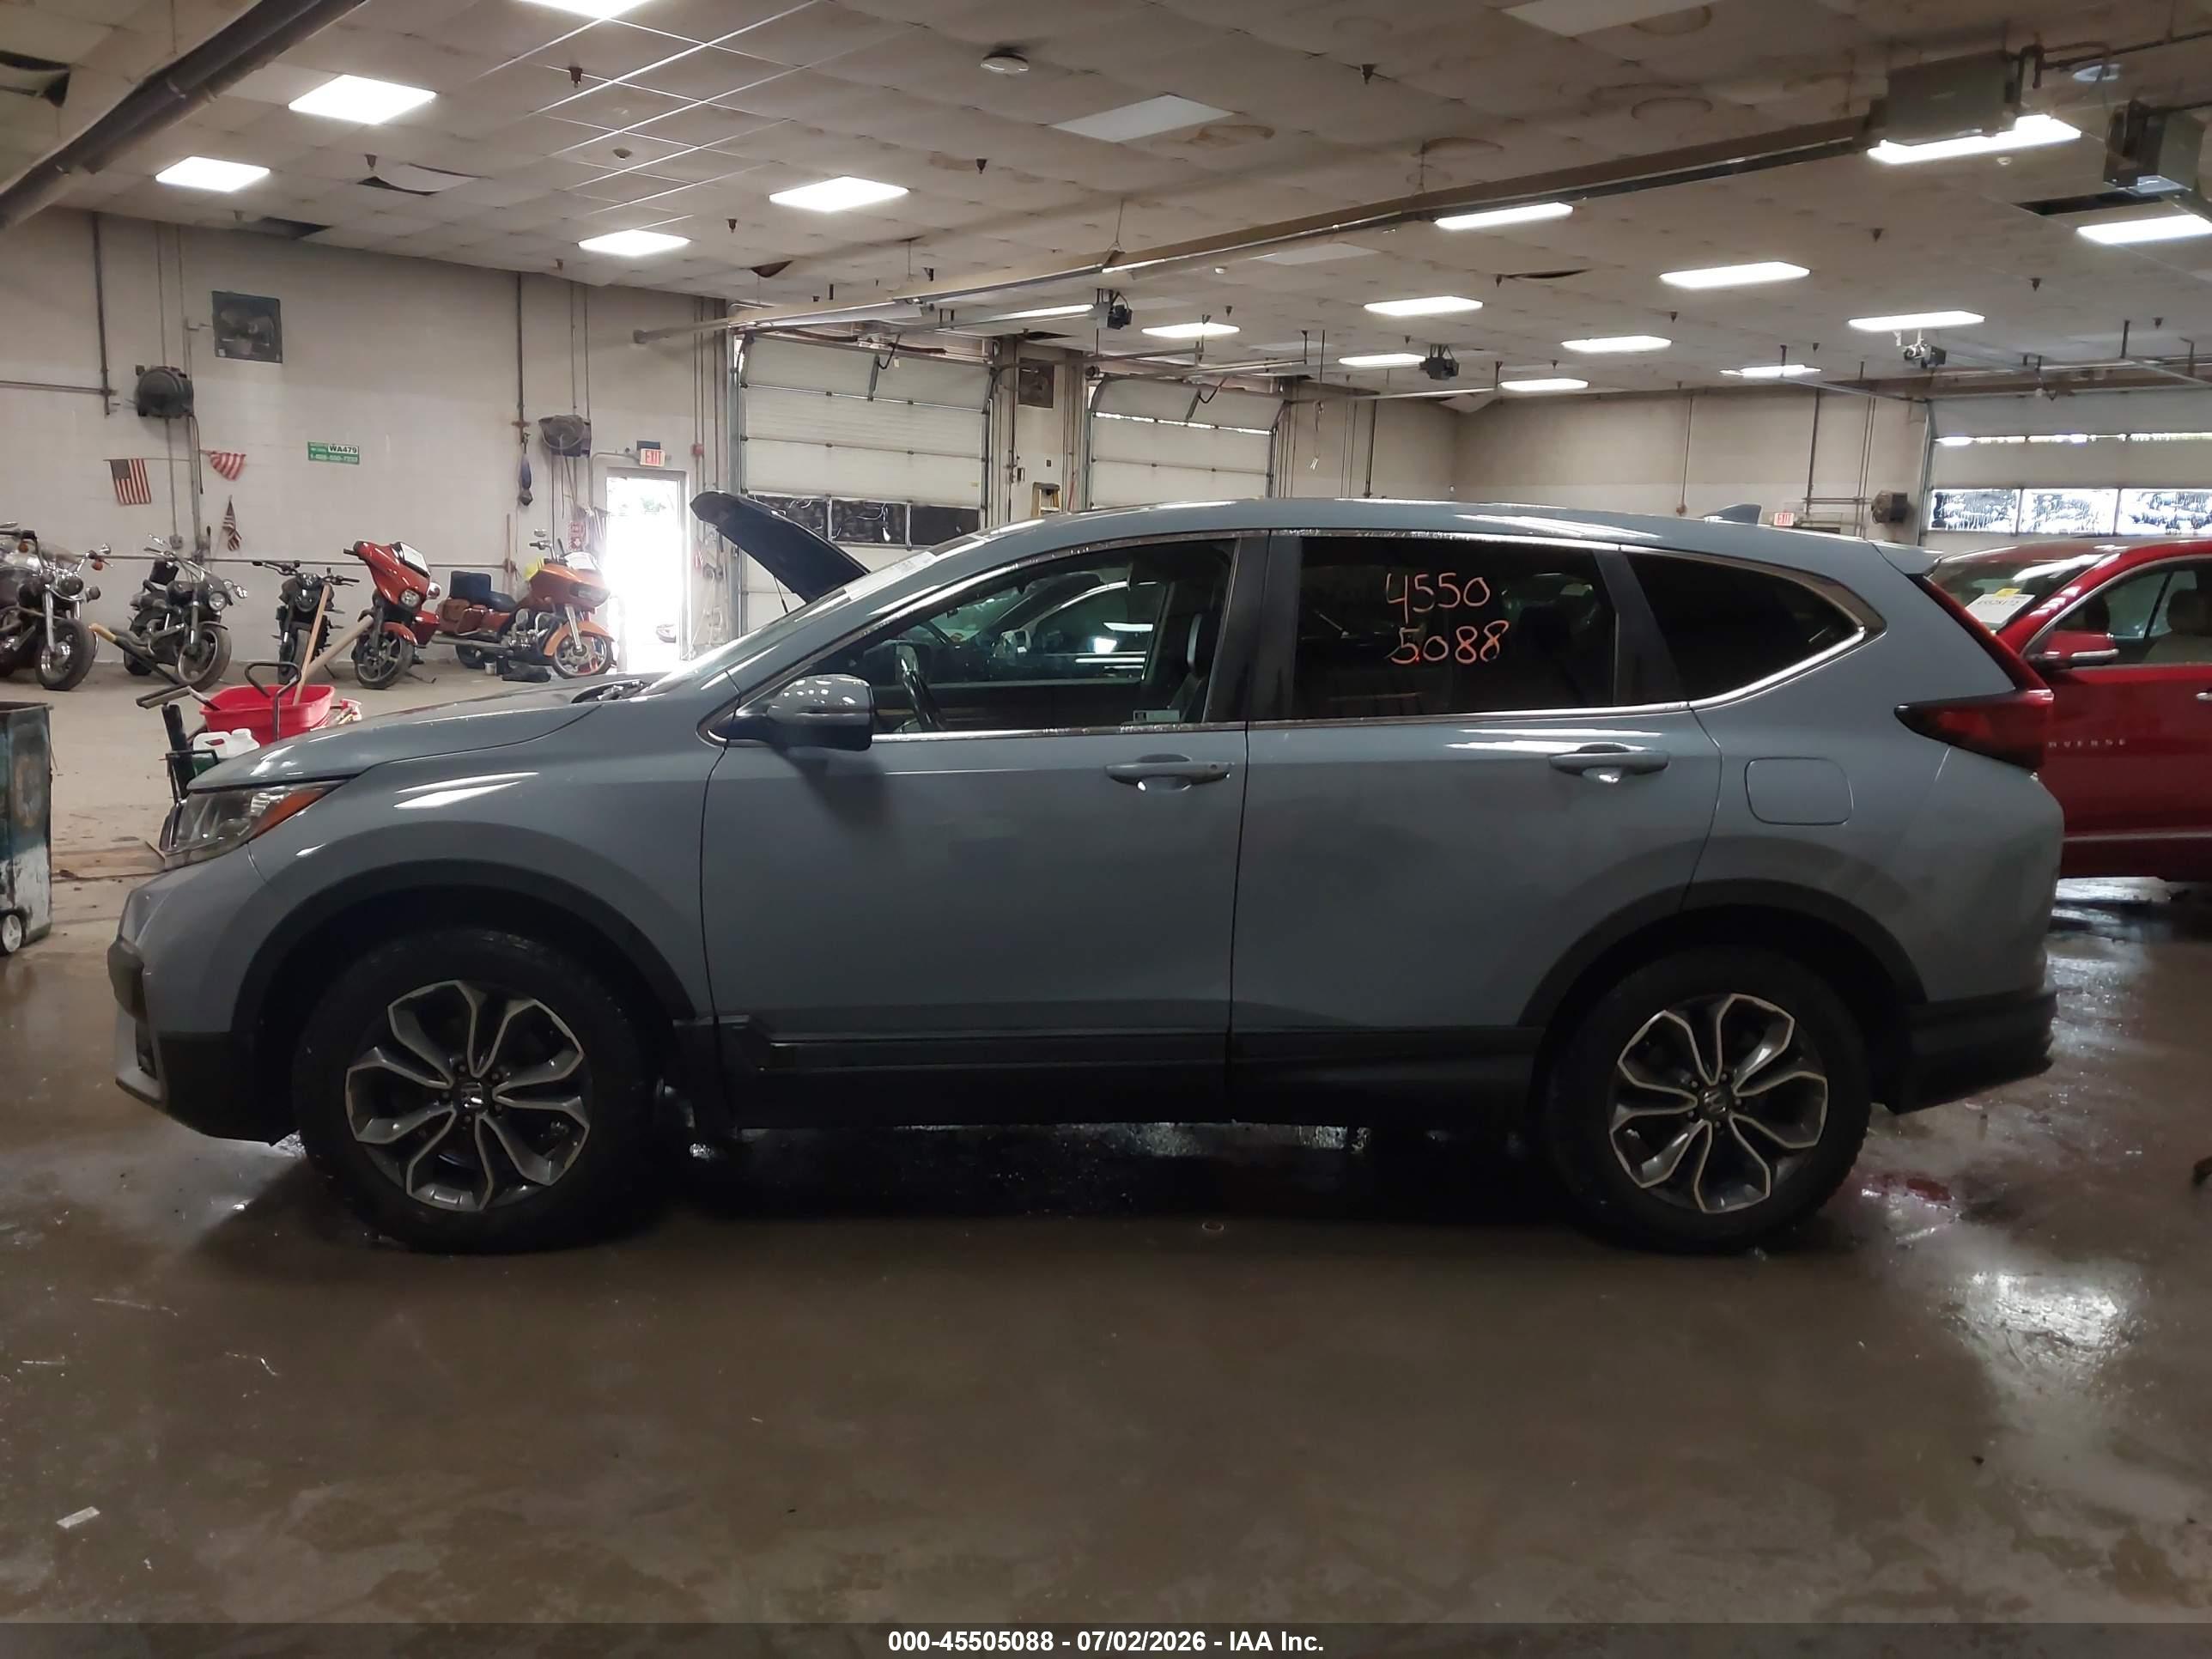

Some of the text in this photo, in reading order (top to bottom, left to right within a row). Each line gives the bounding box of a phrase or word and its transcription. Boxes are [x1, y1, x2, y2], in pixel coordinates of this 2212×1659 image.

[329, 445, 357, 453] WA479
[645, 450, 660, 465] EXIT
[1778, 514, 1791, 524] EXIT
[1386, 573, 1491, 624] 4550
[1384, 620, 1510, 665] 5088
